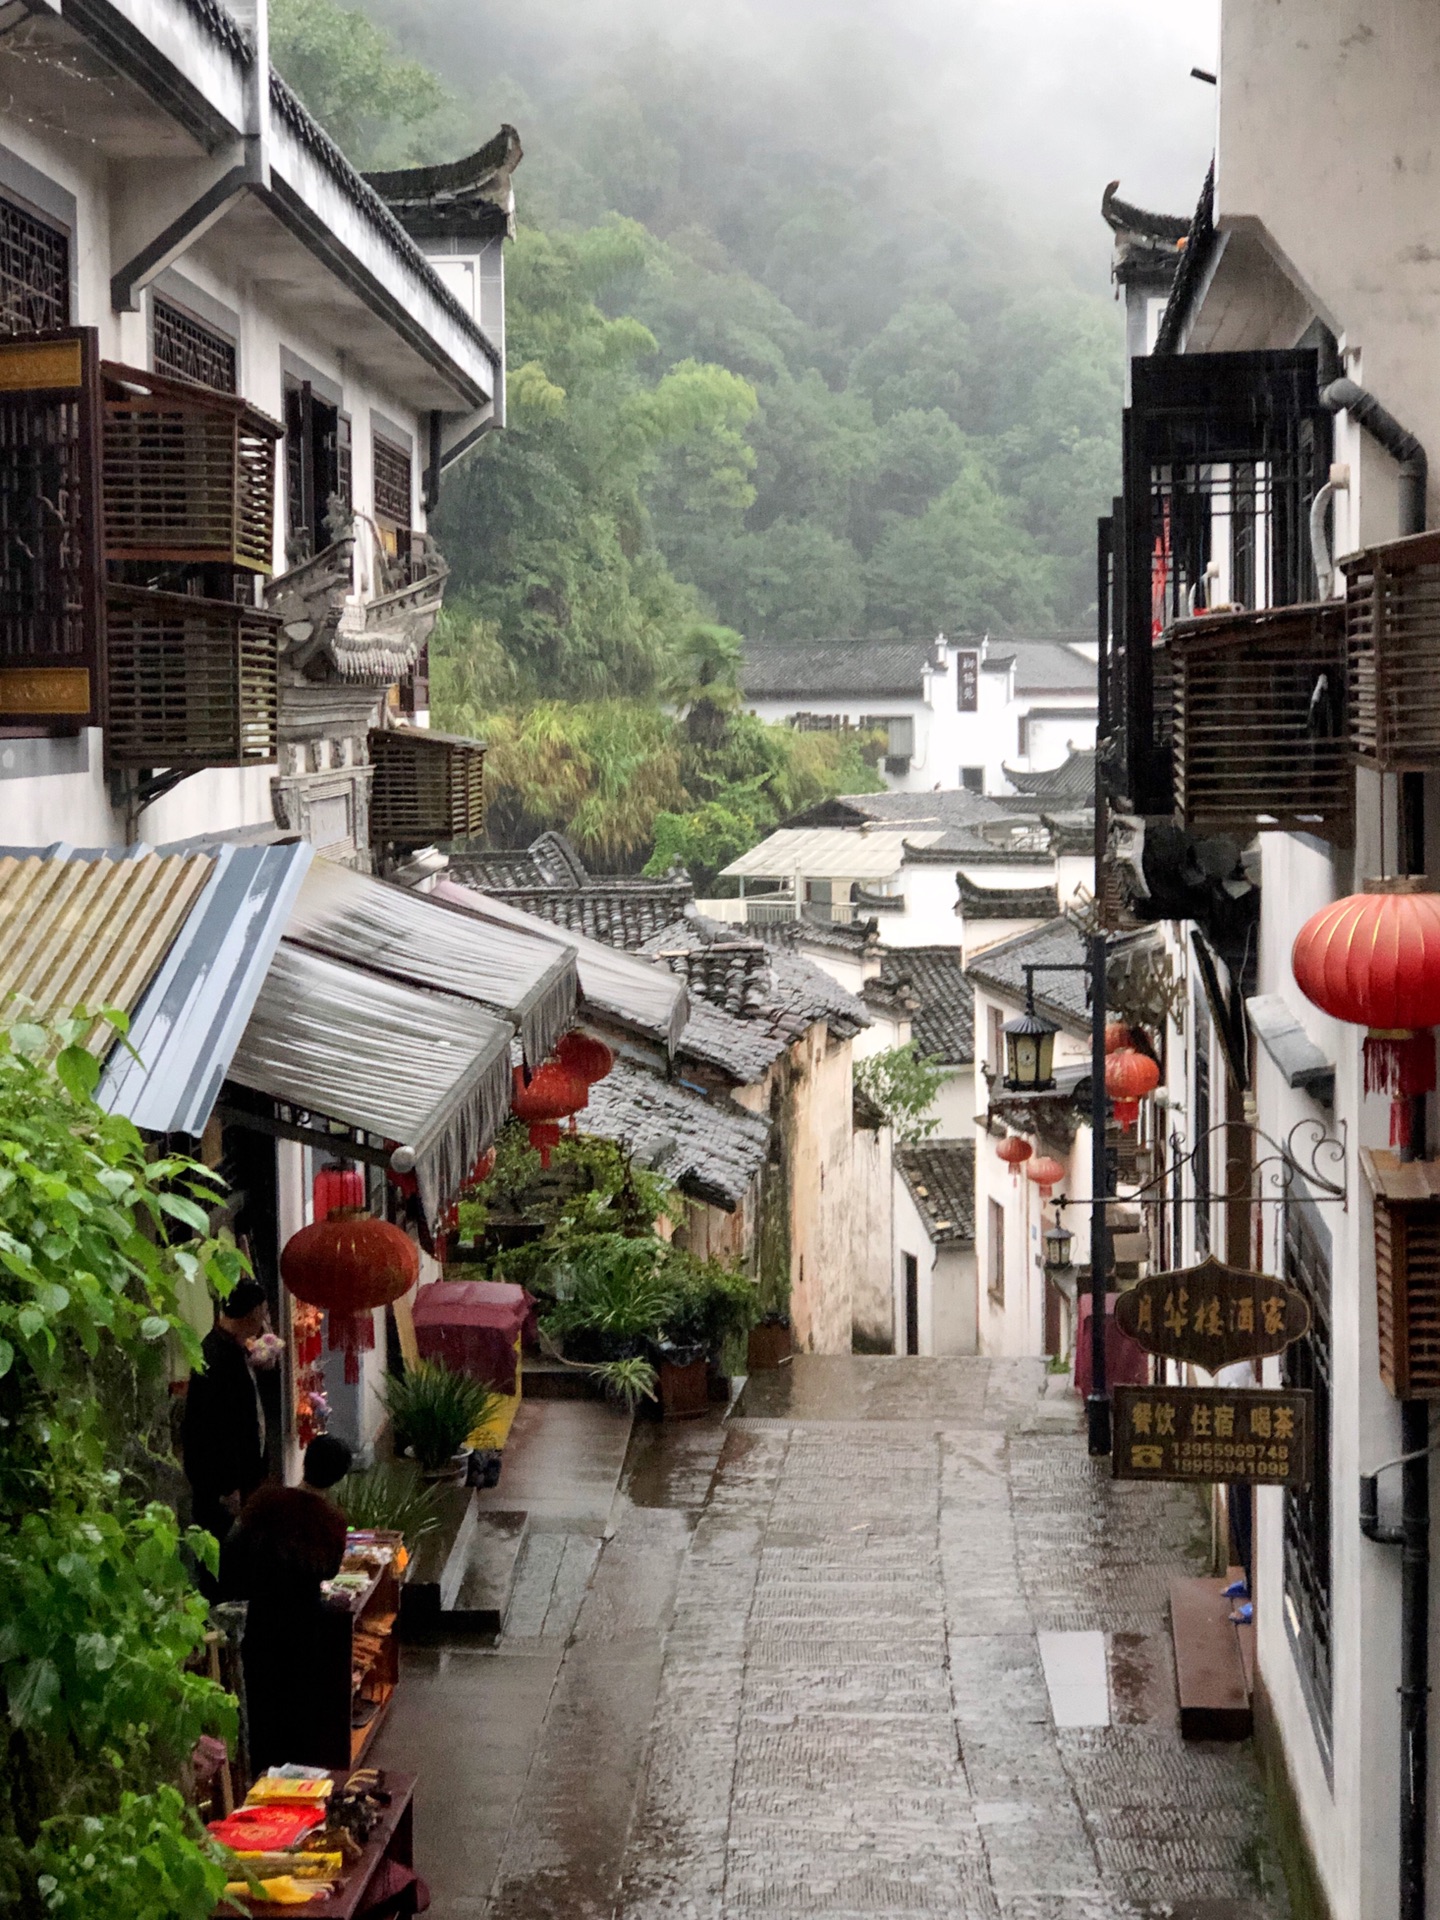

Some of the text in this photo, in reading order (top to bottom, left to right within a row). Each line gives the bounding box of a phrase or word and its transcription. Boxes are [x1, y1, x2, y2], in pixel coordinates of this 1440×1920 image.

[1132, 1402, 1294, 1440] 餐饮 住宿 喝茶
[1172, 1441, 1289, 1460] 13955969748
